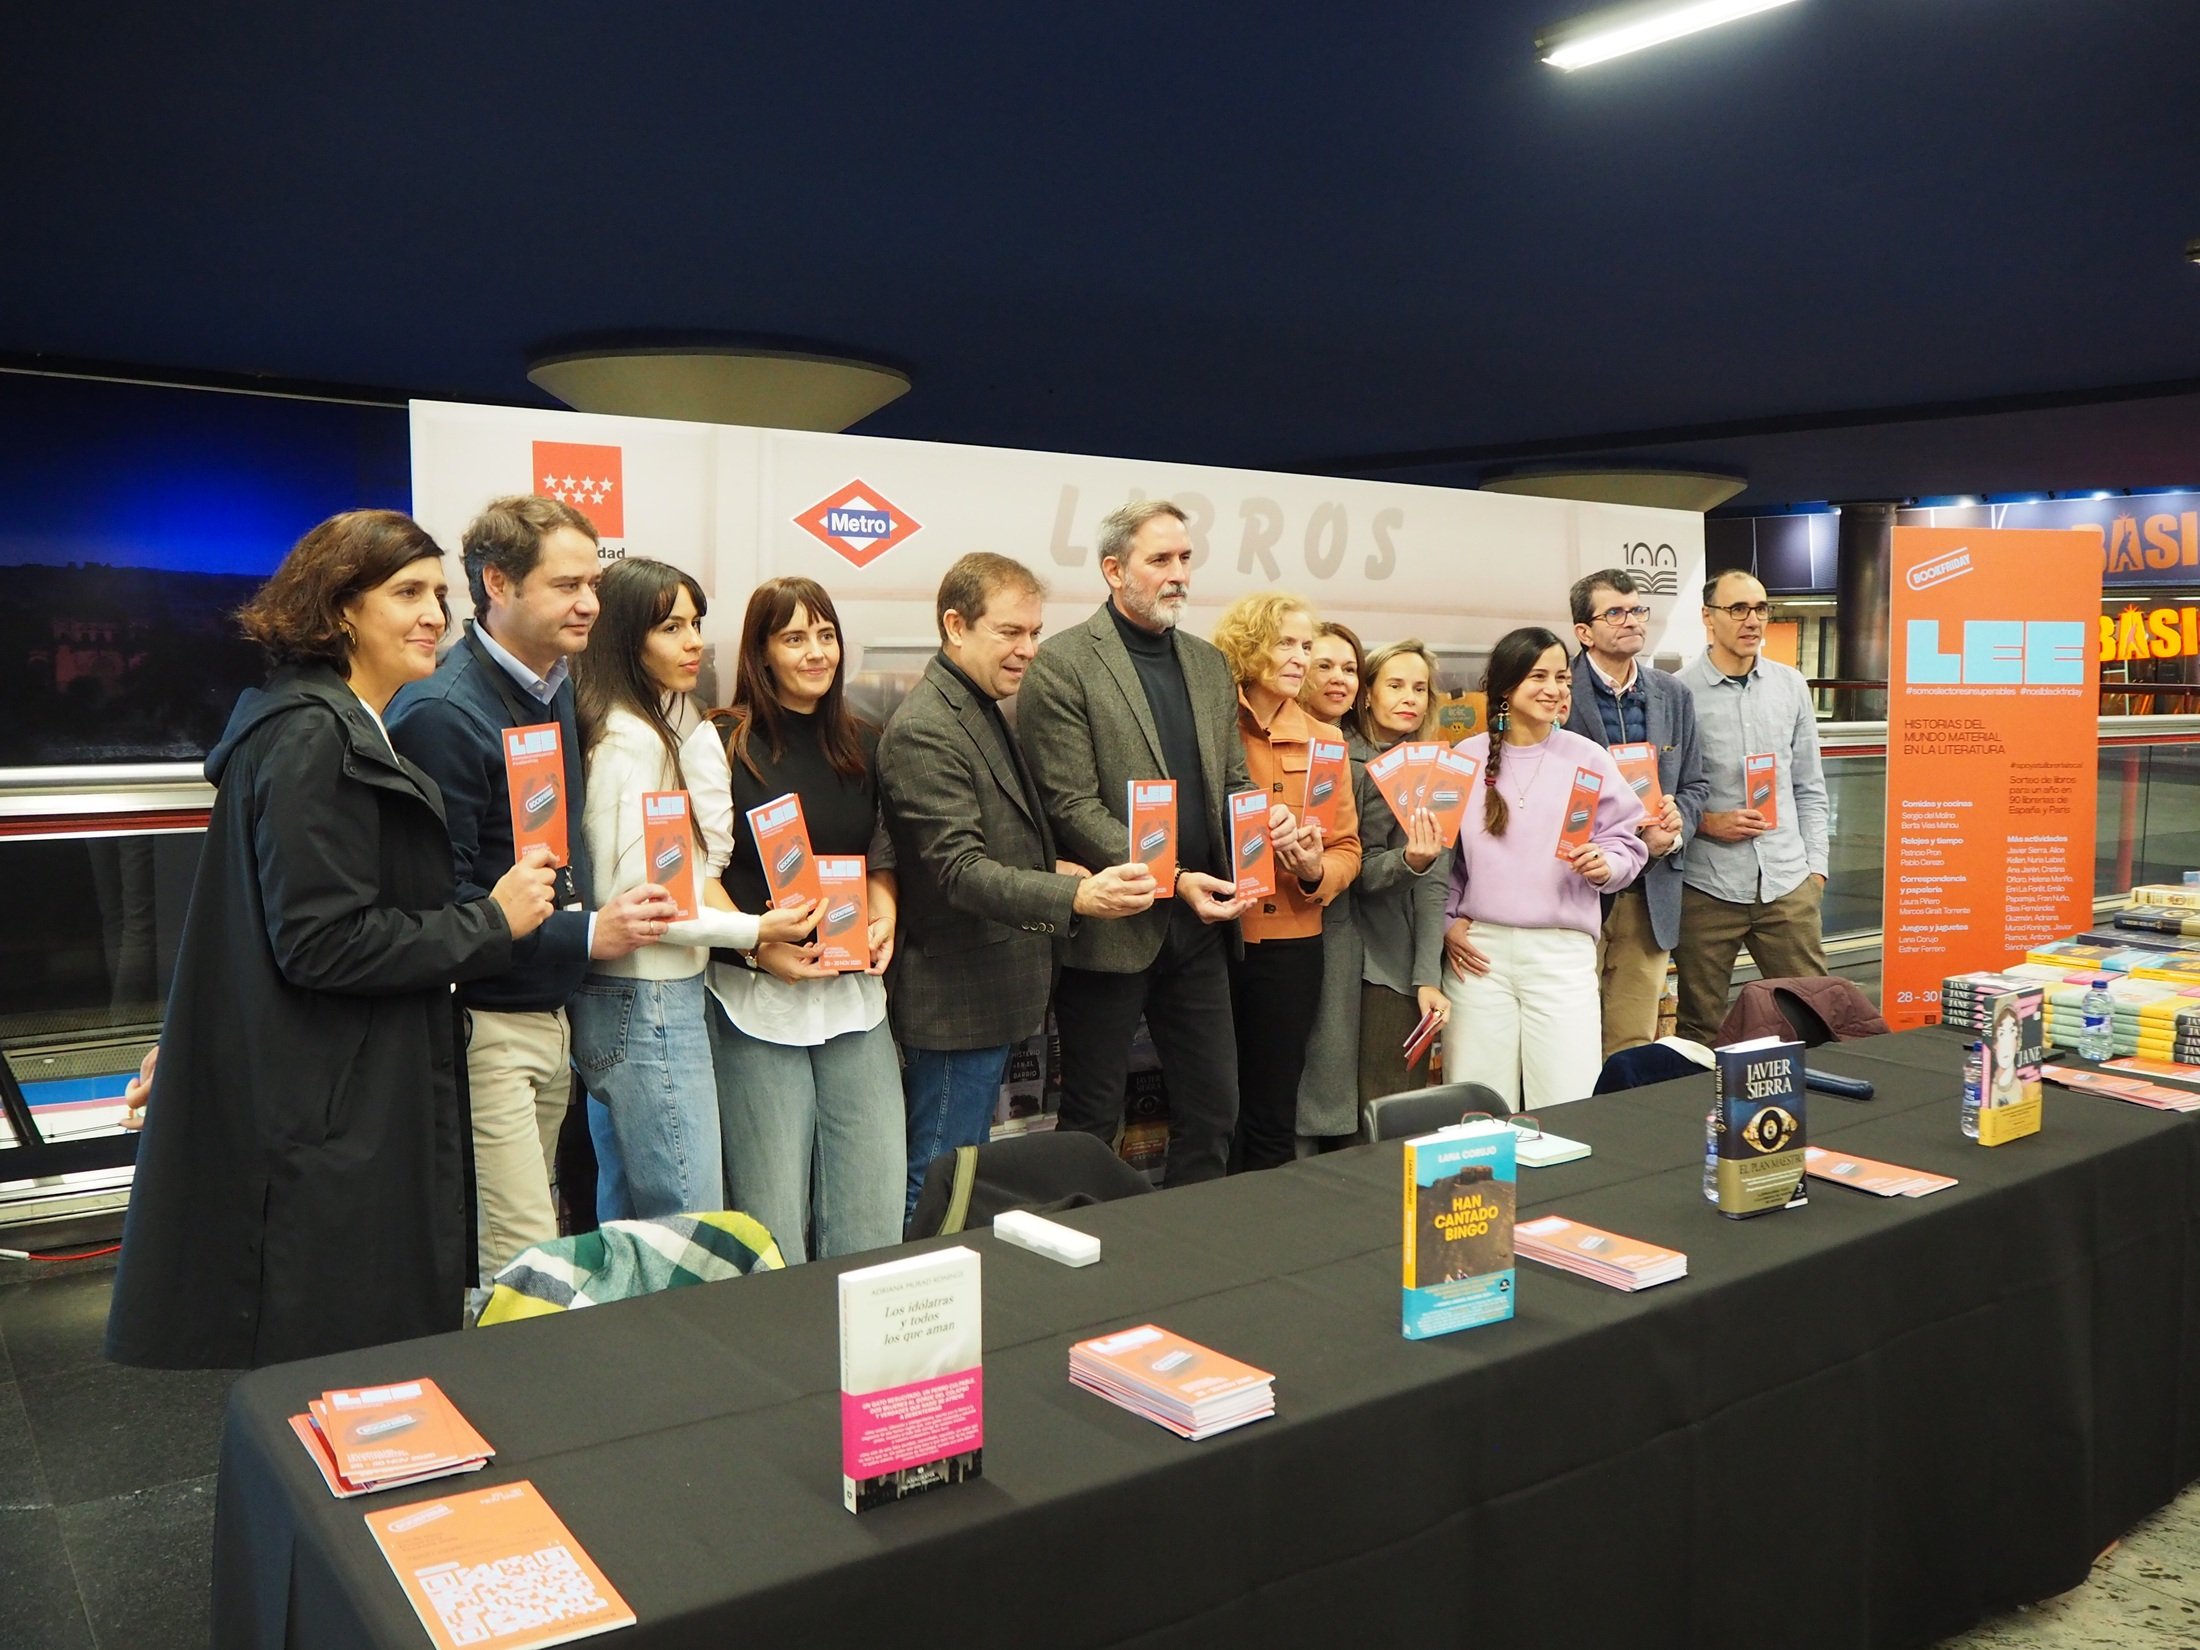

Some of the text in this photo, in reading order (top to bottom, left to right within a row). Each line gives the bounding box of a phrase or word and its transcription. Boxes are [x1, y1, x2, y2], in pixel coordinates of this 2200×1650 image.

[831, 513, 887, 534] Metro
[1913, 554, 1971, 584] BOOKFRIDAY
[1906, 619, 2085, 685] LEE
[1904, 719, 1985, 730] HISTORIAS DEL
[1904, 732, 2002, 742] MUNDO MATERIAL
[1904, 745, 2005, 755] EN LA LITERATURA
[2010, 776, 2076, 784] Sorteo de libros
[2009, 788, 2030, 796] para
[2044, 786, 2059, 794] año
[1902, 812, 1923, 820] Sergio
[2009, 806, 2041, 815] España
[1901, 837, 1929, 846] Relojes
[1936, 837, 1964, 846] tiempo
[1900, 875, 1967, 884] Correspondencia
[1899, 924, 1929, 933] Juegos
[1935, 924, 1969, 933] juguetes
[1950, 981, 1970, 991] JANE
[1897, 991, 1913, 1003] 28
[1923, 991, 1938, 1002] 30
[1949, 990, 1970, 1000] JANE
[1948, 999, 1969, 1009] JANE
[1948, 1008, 1968, 1018] JANE
[1948, 1017, 1969, 1027] JANE
[1982, 1010, 1993, 1037] JANE
[2016, 1045, 2042, 1068] JANE
[1746, 1059, 1791, 1084] JAVIER
[1715, 1065, 1725, 1122] JAVIER SIERRA
[1746, 1078, 1793, 1100] SIERRA
[1438, 1145, 1497, 1164] LANA CORUJO
[1739, 1164, 1749, 1175] EL
[1751, 1160, 1770, 1173] PLAN
[1452, 1193, 1482, 1212] HAN
[1434, 1205, 1499, 1230] CANTADO
[1444, 1222, 1489, 1242] BINGO
[871, 1284, 905, 1296] ADRIANA
[905, 1277, 932, 1290] MURAD
[885, 1295, 954, 1318] Los idólatras
[899, 1311, 940, 1331] y todos
[884, 1321, 956, 1346] los que aman
